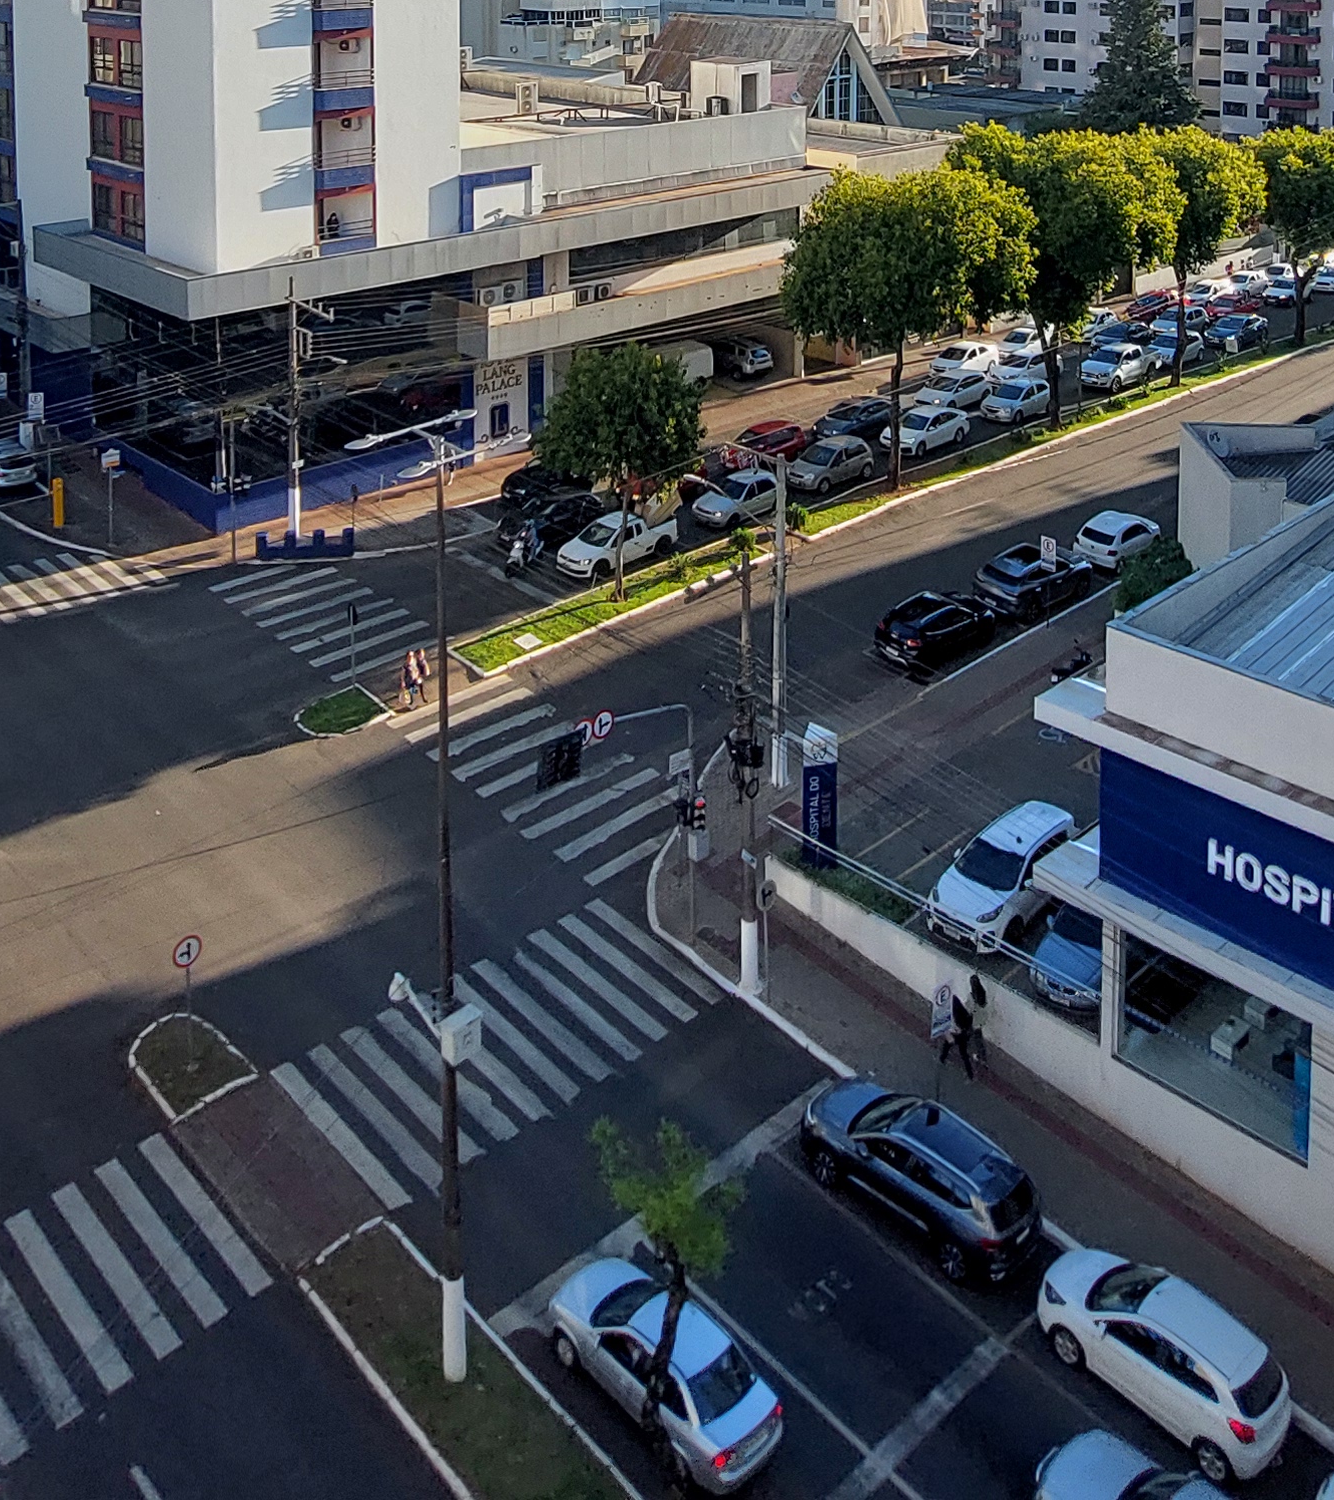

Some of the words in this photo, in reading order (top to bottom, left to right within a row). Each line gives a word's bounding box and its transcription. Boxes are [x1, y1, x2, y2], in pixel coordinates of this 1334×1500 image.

[483, 363, 516, 381] LANG
[475, 374, 523, 396] PALACE
[809, 776, 820, 792] DO
